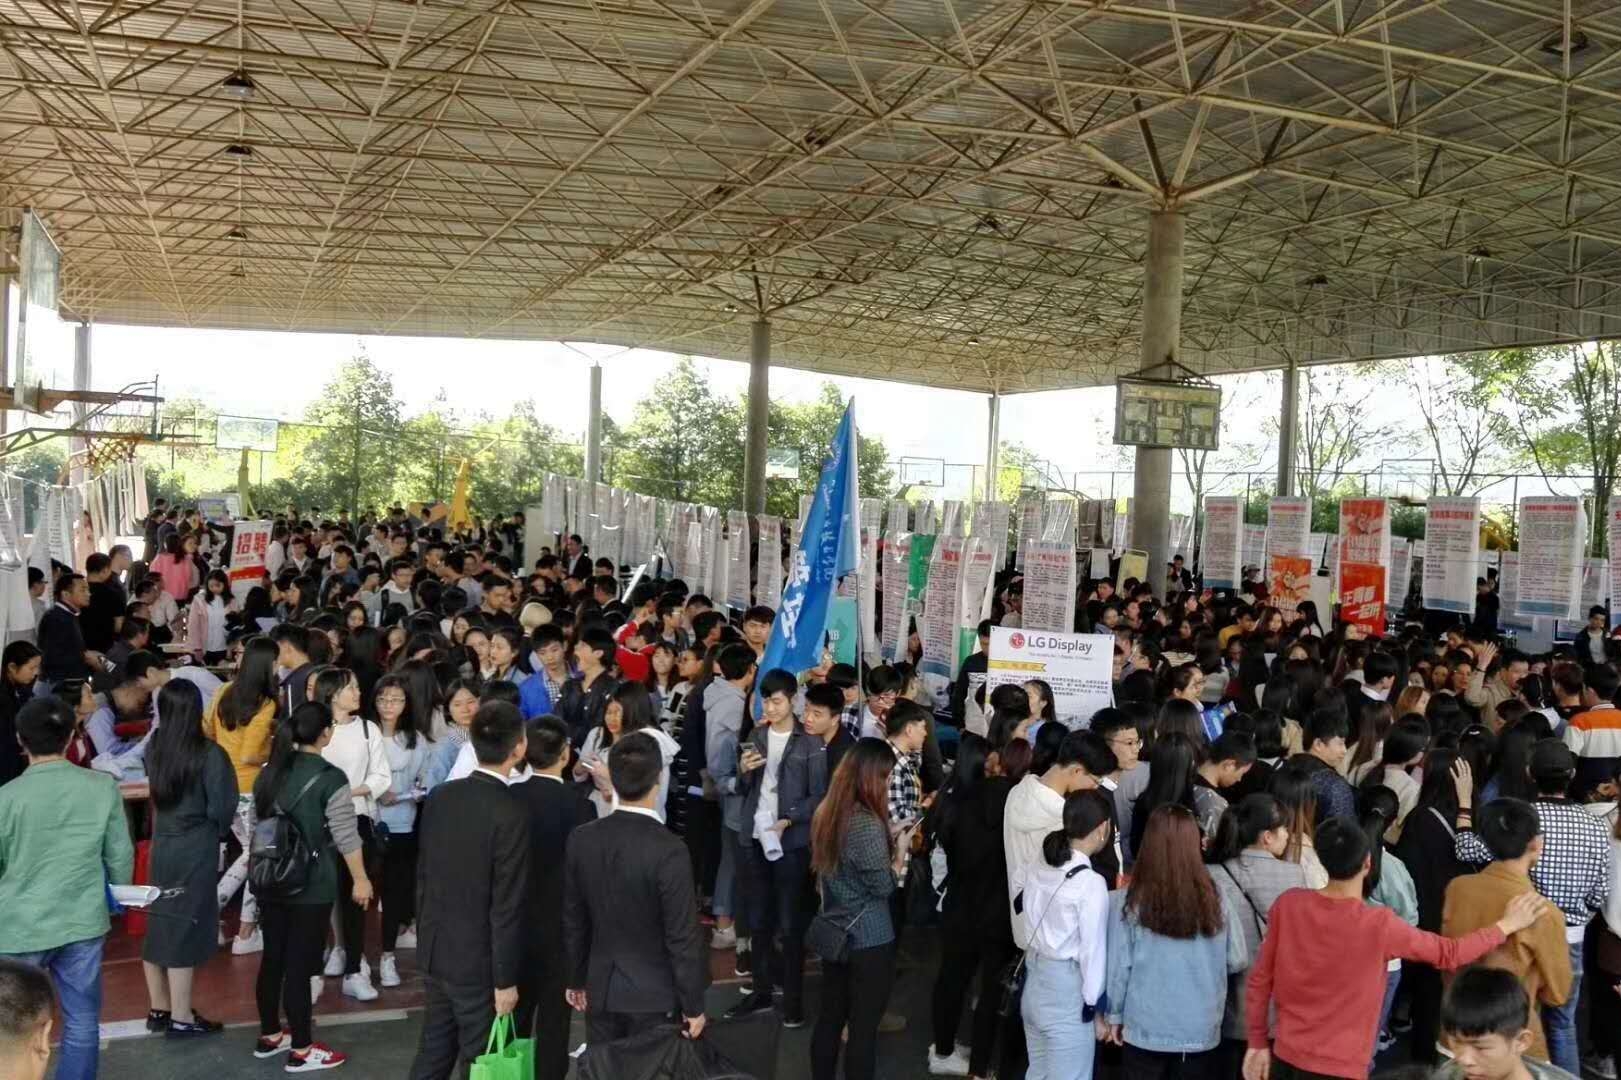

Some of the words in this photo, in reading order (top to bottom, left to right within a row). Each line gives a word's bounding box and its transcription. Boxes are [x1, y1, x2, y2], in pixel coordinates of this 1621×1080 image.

[236, 531, 268, 561] 招聘
[1028, 635, 1046, 649] LG
[1048, 637, 1092, 655] Display
